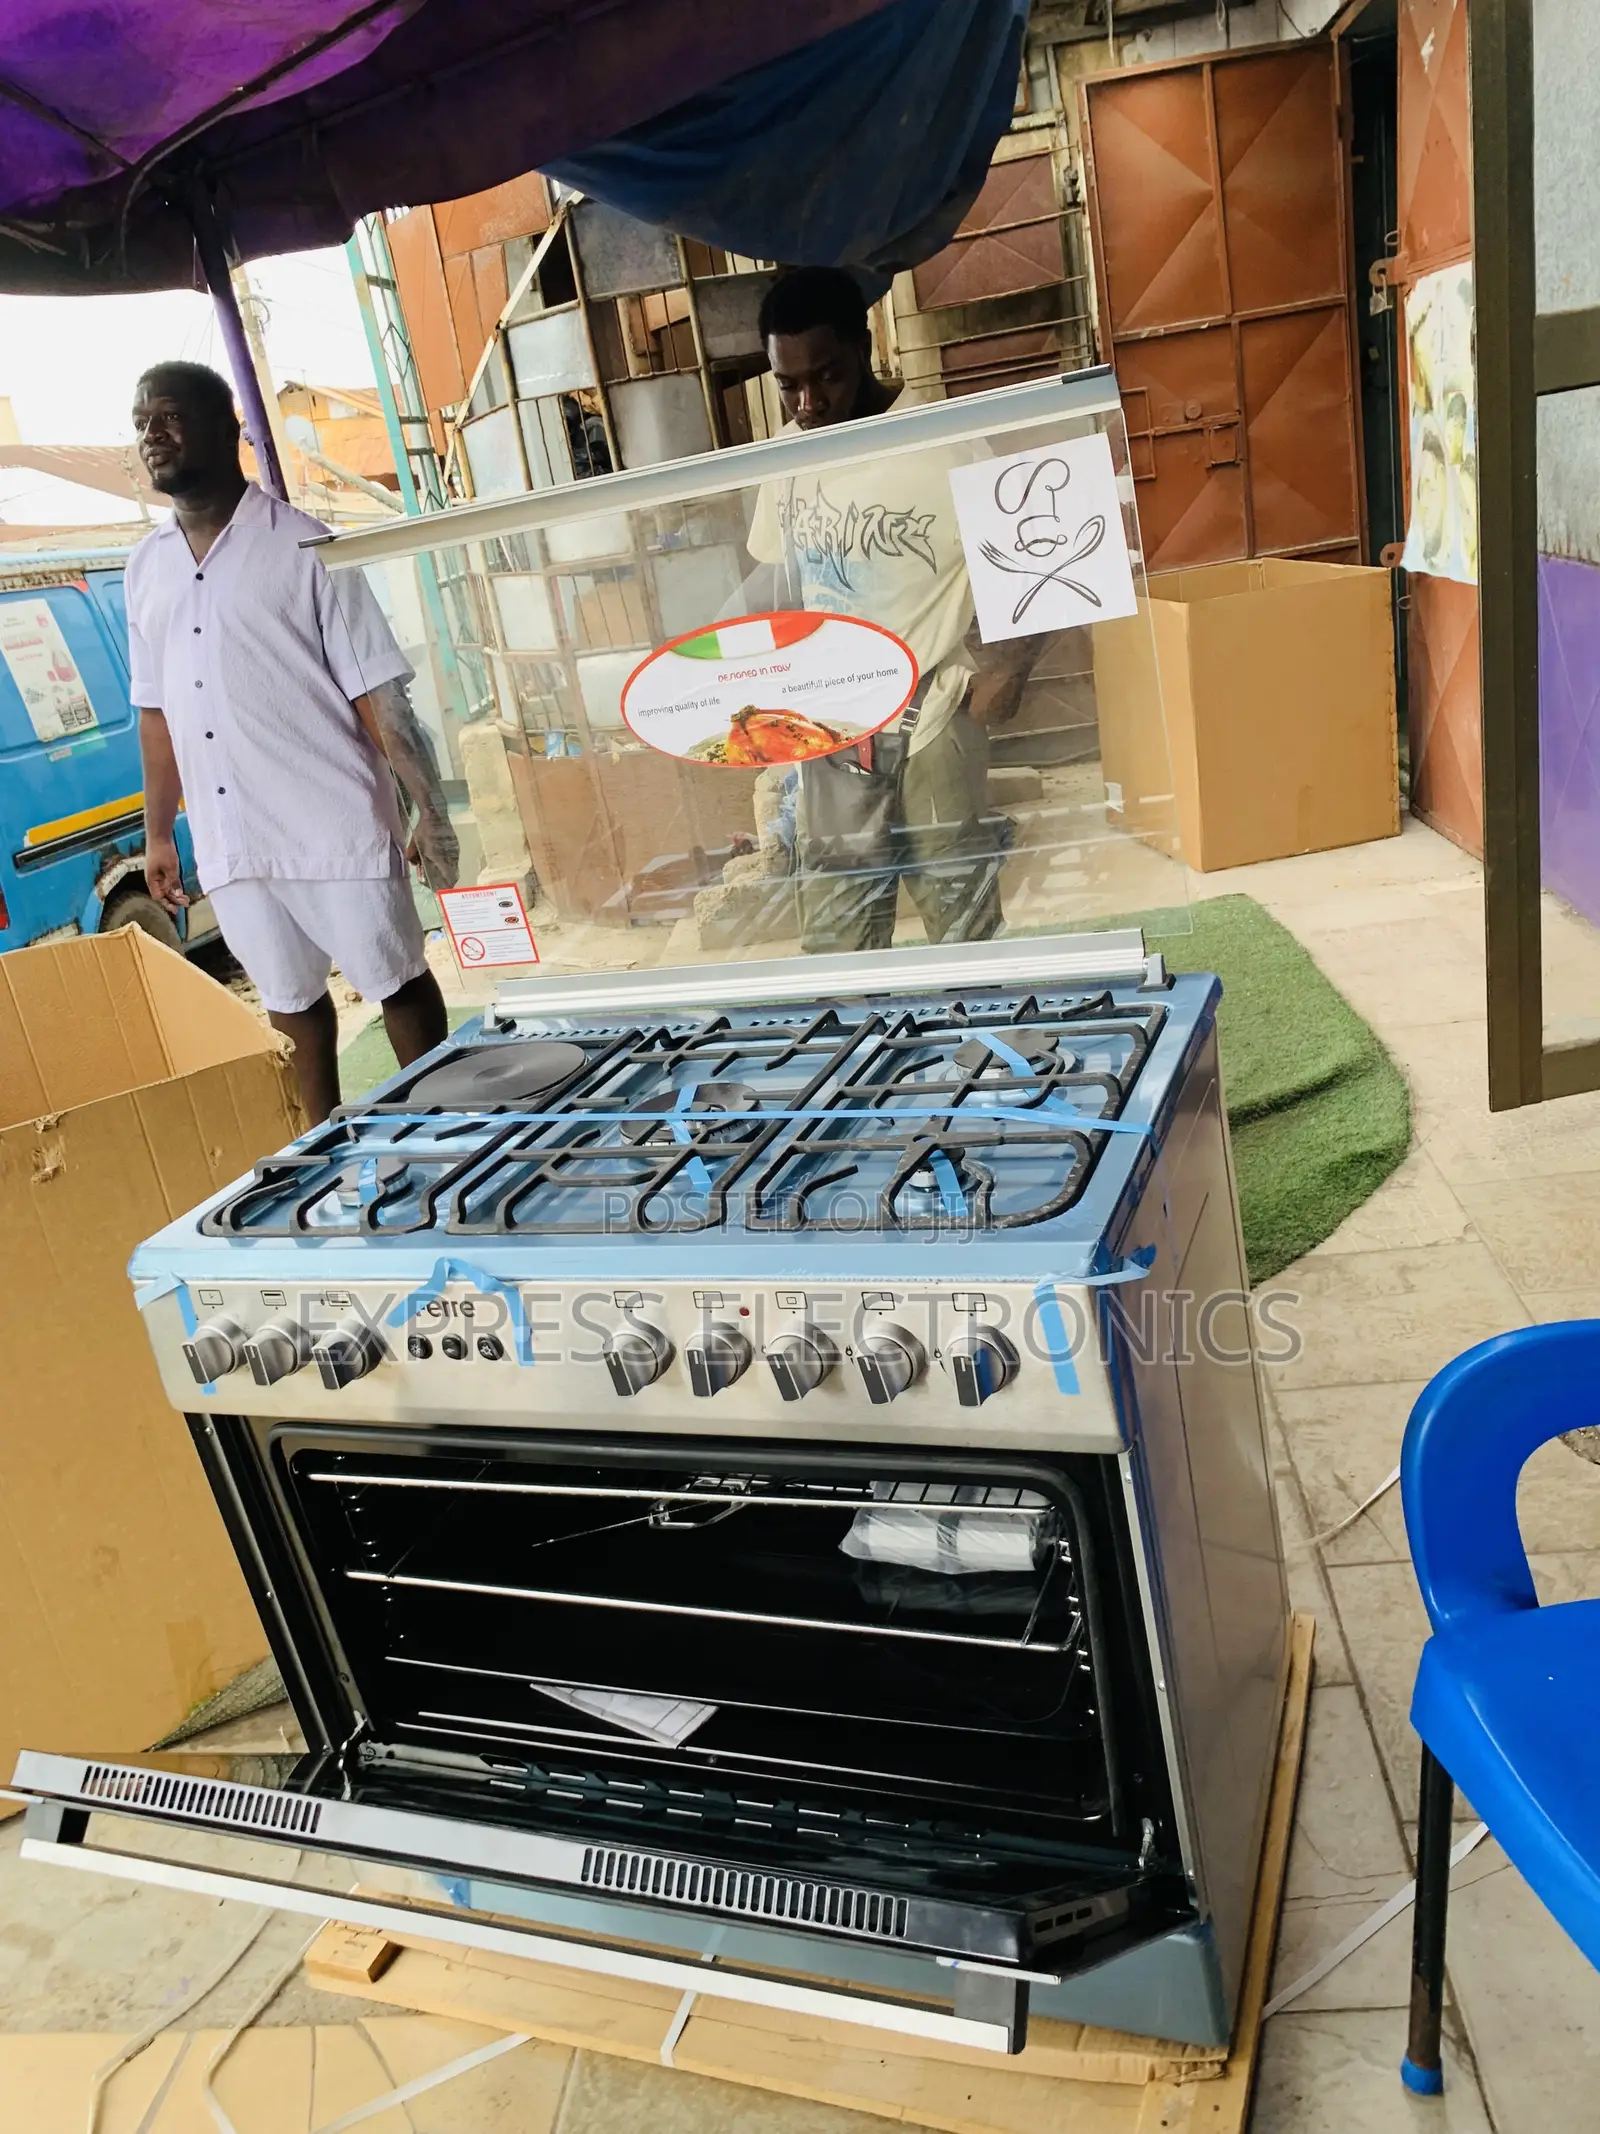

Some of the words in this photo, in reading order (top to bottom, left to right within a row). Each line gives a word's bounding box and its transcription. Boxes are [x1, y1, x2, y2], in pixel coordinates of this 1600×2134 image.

[825, 677, 845, 688] piece
[847, 673, 855, 683] of
[857, 671, 874, 683] your
[876, 667, 898, 678] home
[674, 701, 699, 712] quality
[700, 697, 707, 707] of
[708, 697, 721, 706] life
